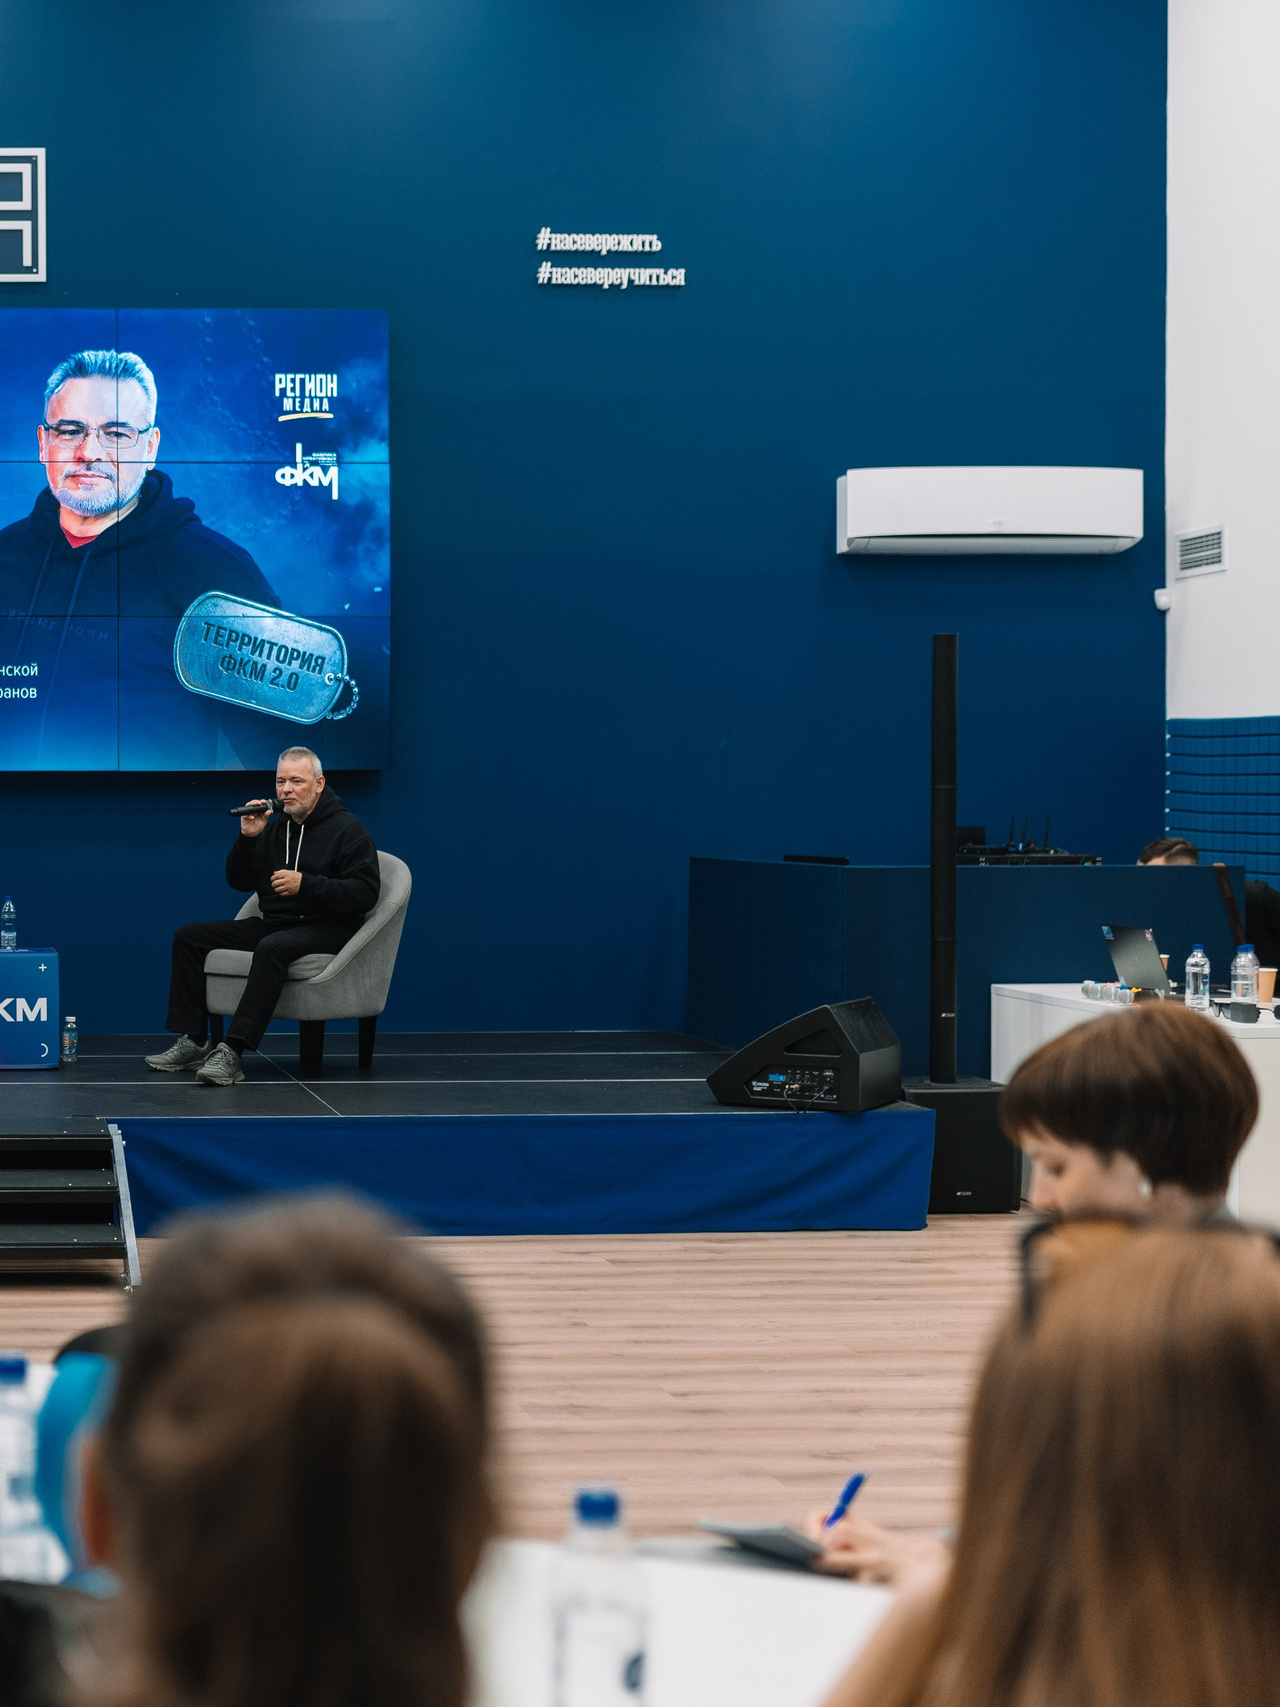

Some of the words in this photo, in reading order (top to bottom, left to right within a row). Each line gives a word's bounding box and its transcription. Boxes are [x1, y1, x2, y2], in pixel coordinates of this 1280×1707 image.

[535, 226, 662, 256] #насевережить
[536, 260, 686, 290] #насевереучиться
[274, 373, 338, 397] РЕГИОН
[283, 397, 330, 413] МЕДИА
[274, 442, 339, 500] ФКМ
[201, 621, 326, 676] ТЕРРИТОРИЯ
[219, 654, 267, 685] ФКМ
[269, 667, 300, 693] 2.0
